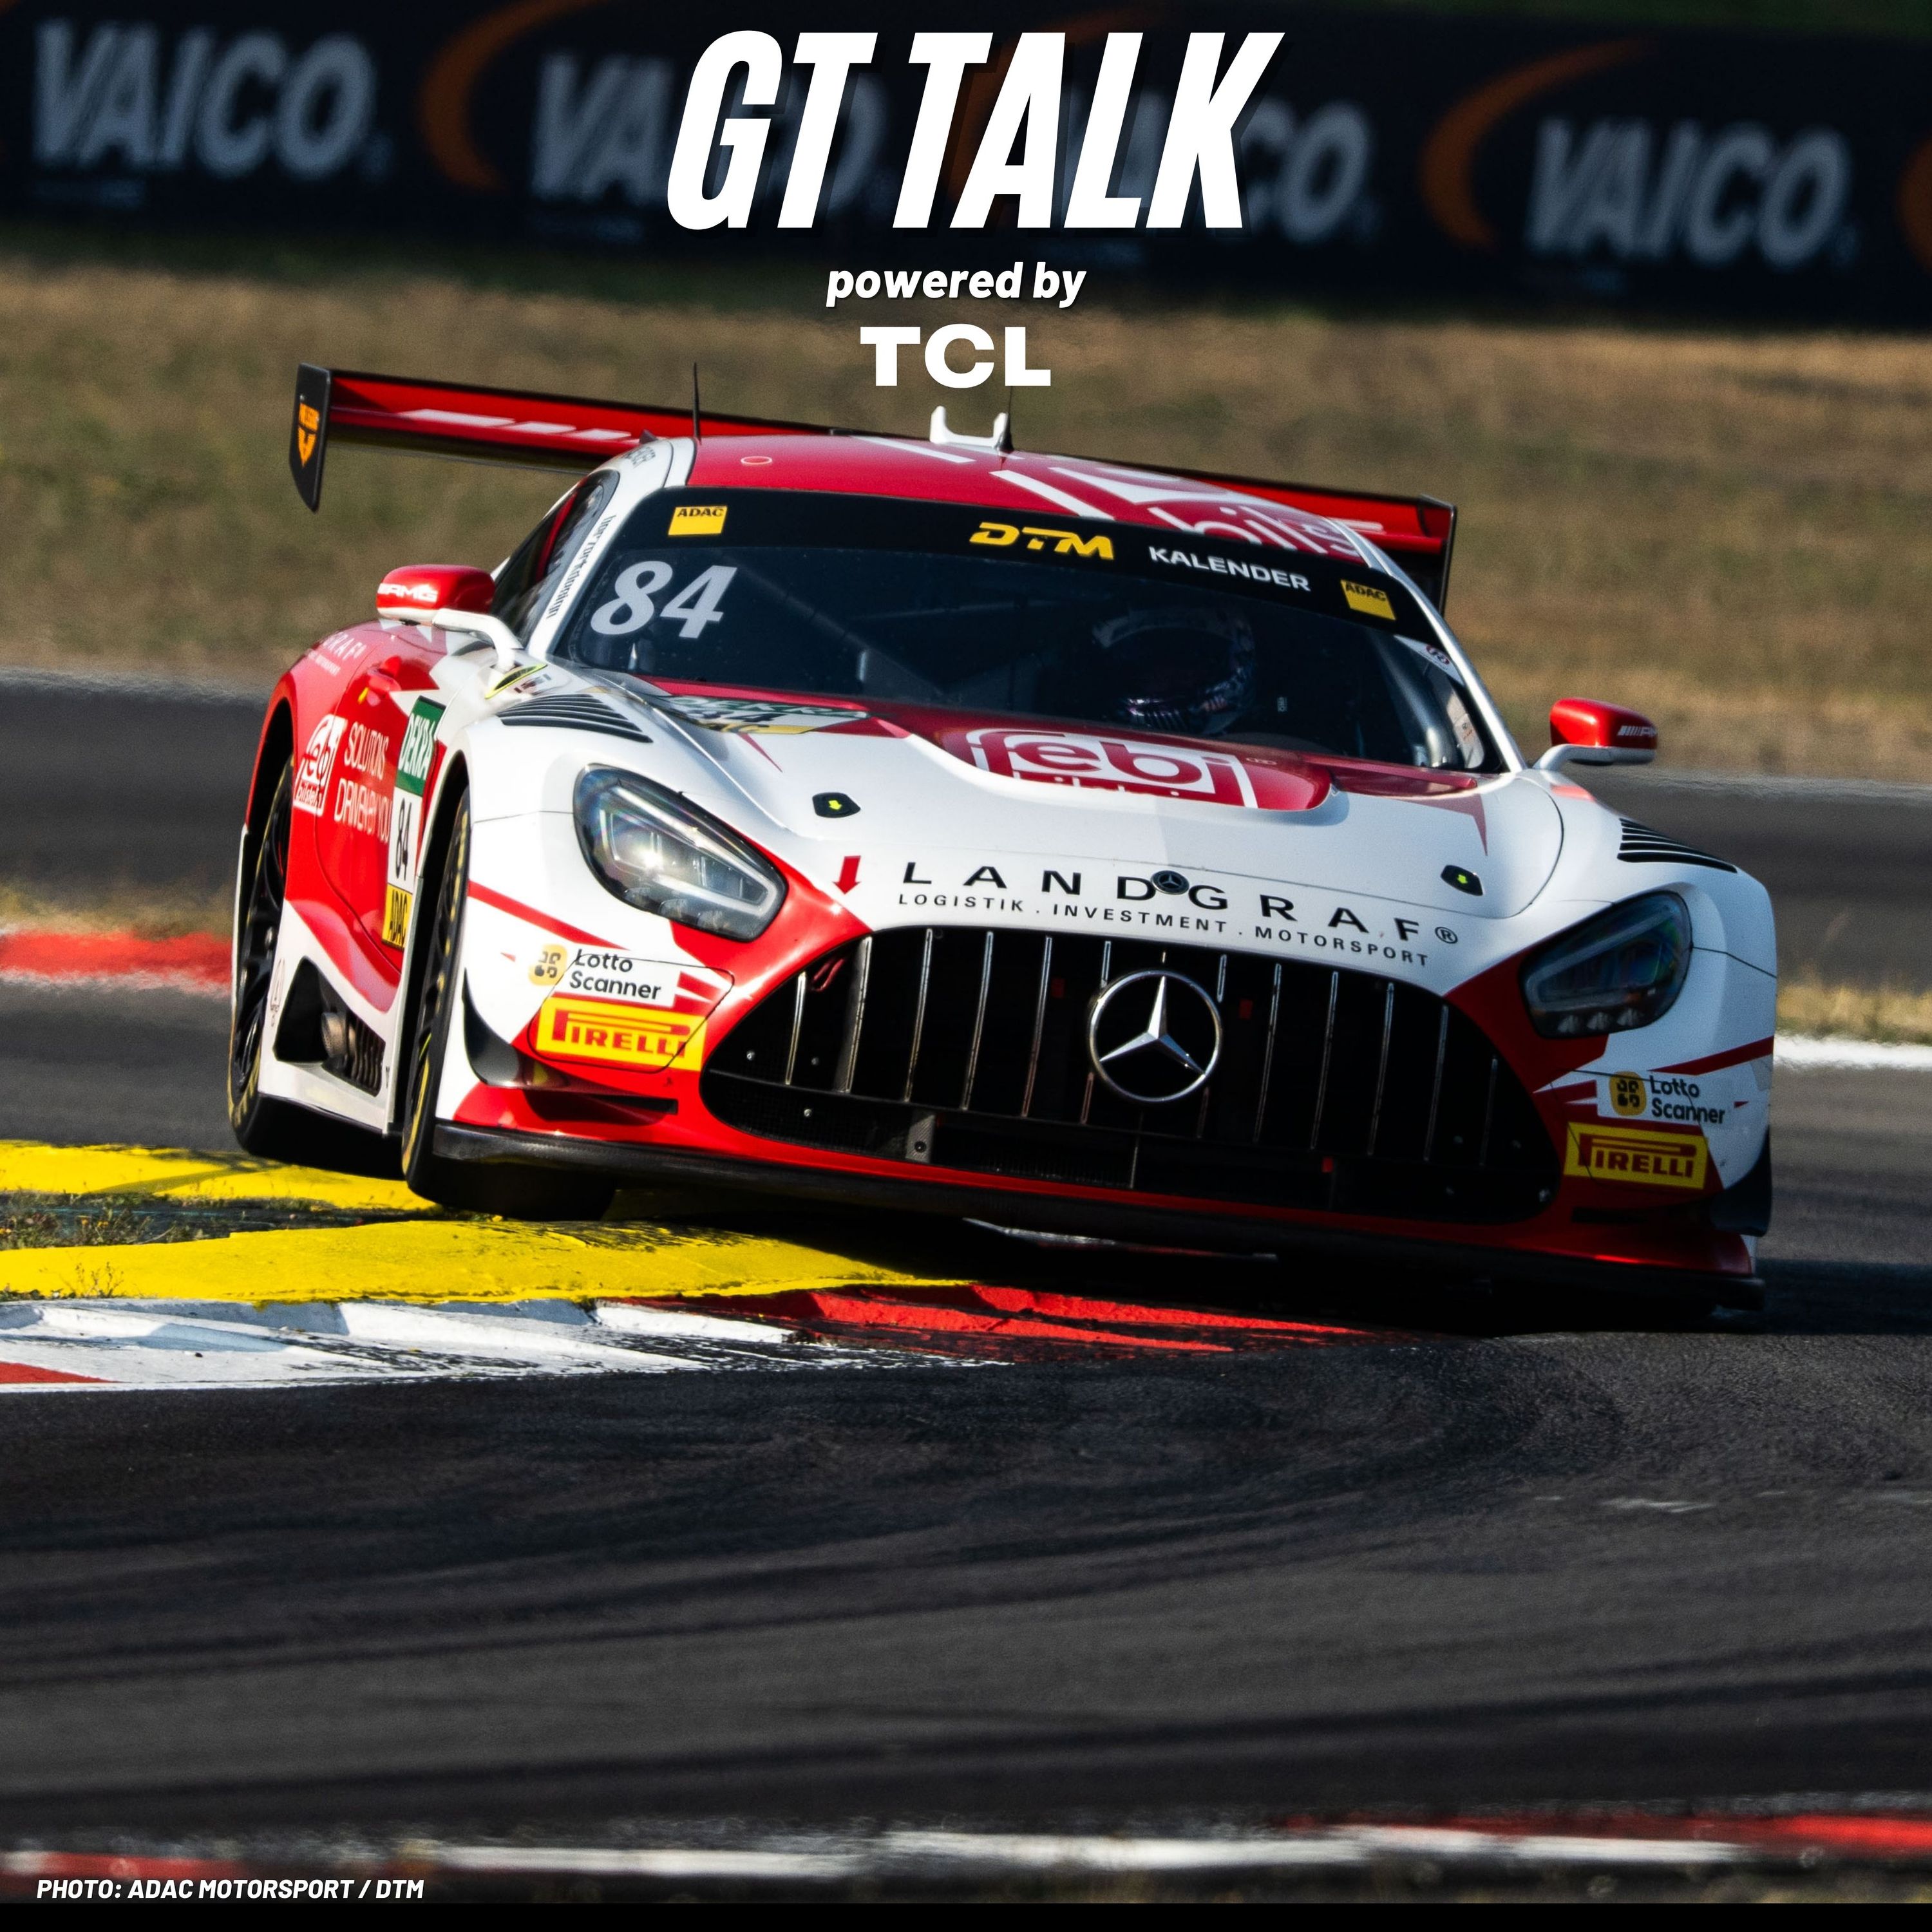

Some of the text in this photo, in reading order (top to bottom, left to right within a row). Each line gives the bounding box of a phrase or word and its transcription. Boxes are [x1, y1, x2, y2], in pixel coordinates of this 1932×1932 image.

[33, 21, 376, 178] VAICO
[1528, 117, 1850, 267] VAICO
[676, 507, 724, 518] ADAC
[969, 522, 1115, 560] DTM
[1148, 546, 1311, 593] KALENDER
[1345, 582, 1387, 601] ADAC
[591, 560, 738, 639] 84
[344, 721, 389, 781] SOLUTIONS
[398, 712, 436, 781] DEKRA
[969, 731, 1246, 807] febi
[396, 798, 412, 881] 84
[388, 889, 408, 947] ADAC
[899, 893, 1025, 913] LOGISTIK
[1053, 903, 1227, 934] INVESTMENT
[1255, 925, 1428, 967] MOTORSPORT
[569, 971, 661, 1000] Scanner
[574, 949, 633, 973] Lotto
[551, 1008, 691, 1058] PIRELLI
[1649, 1075, 1700, 1099] Lotto
[1651, 1097, 1726, 1124] Scanner
[1578, 1132, 1697, 1179] PIRELLI
